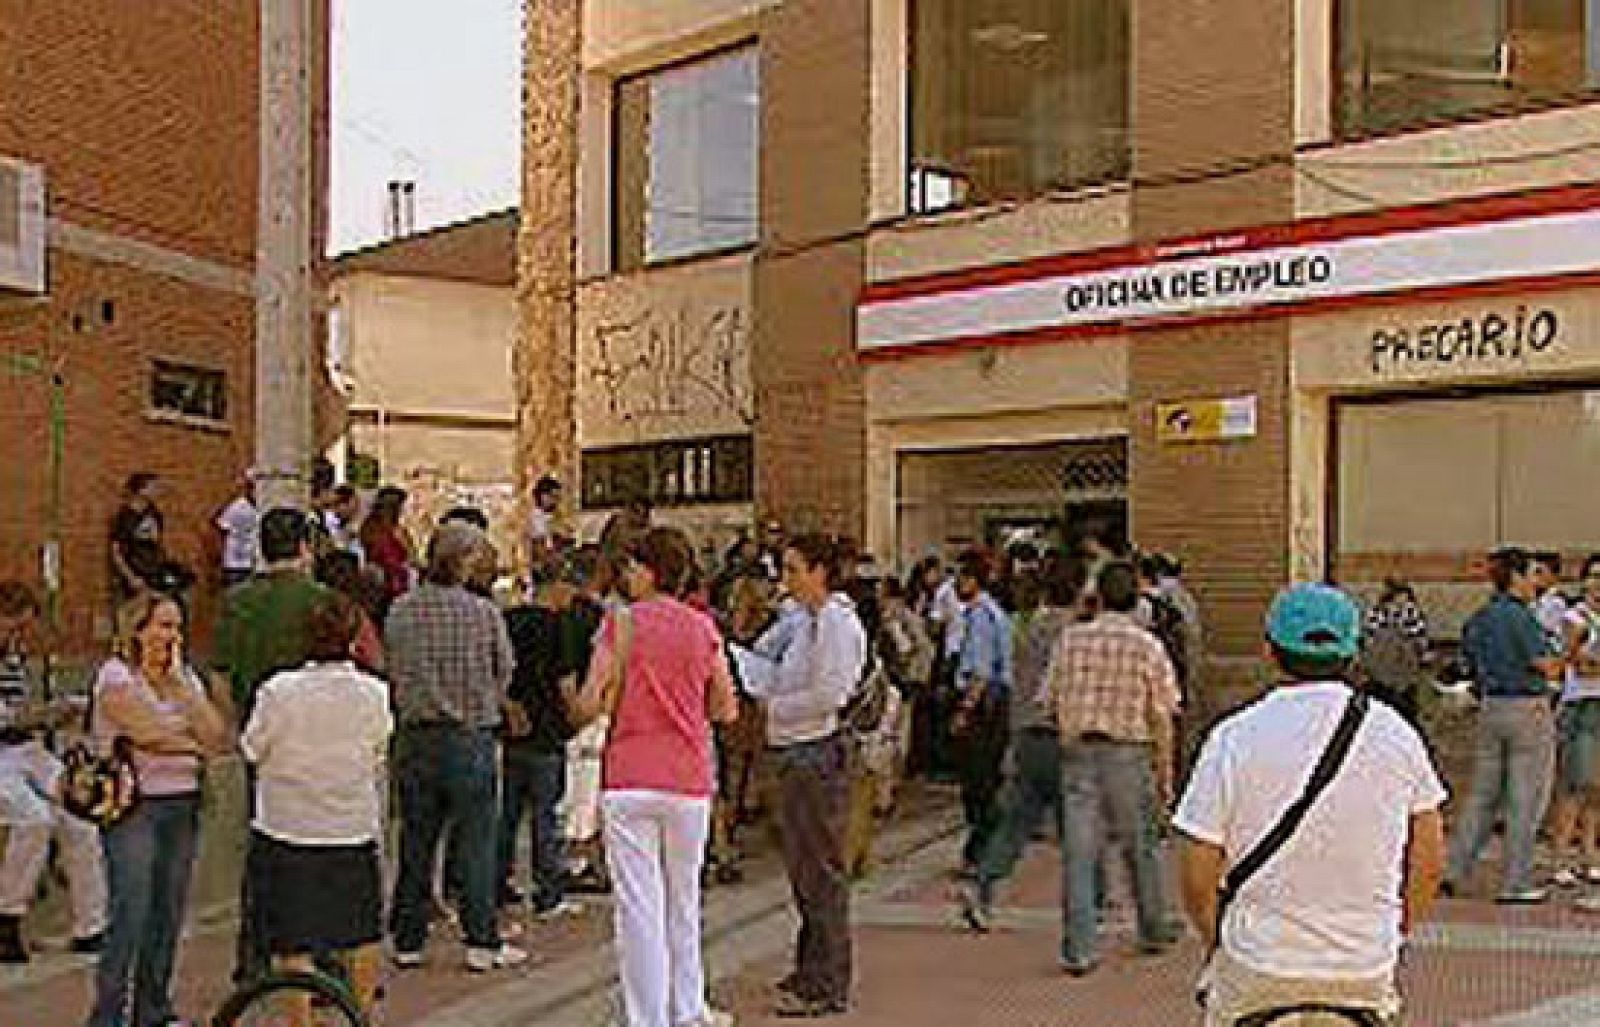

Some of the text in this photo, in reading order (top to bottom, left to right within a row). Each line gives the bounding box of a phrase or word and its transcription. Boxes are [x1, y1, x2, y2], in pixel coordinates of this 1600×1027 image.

[1066, 255, 1331, 313] OFICINA DE EMPLEO
